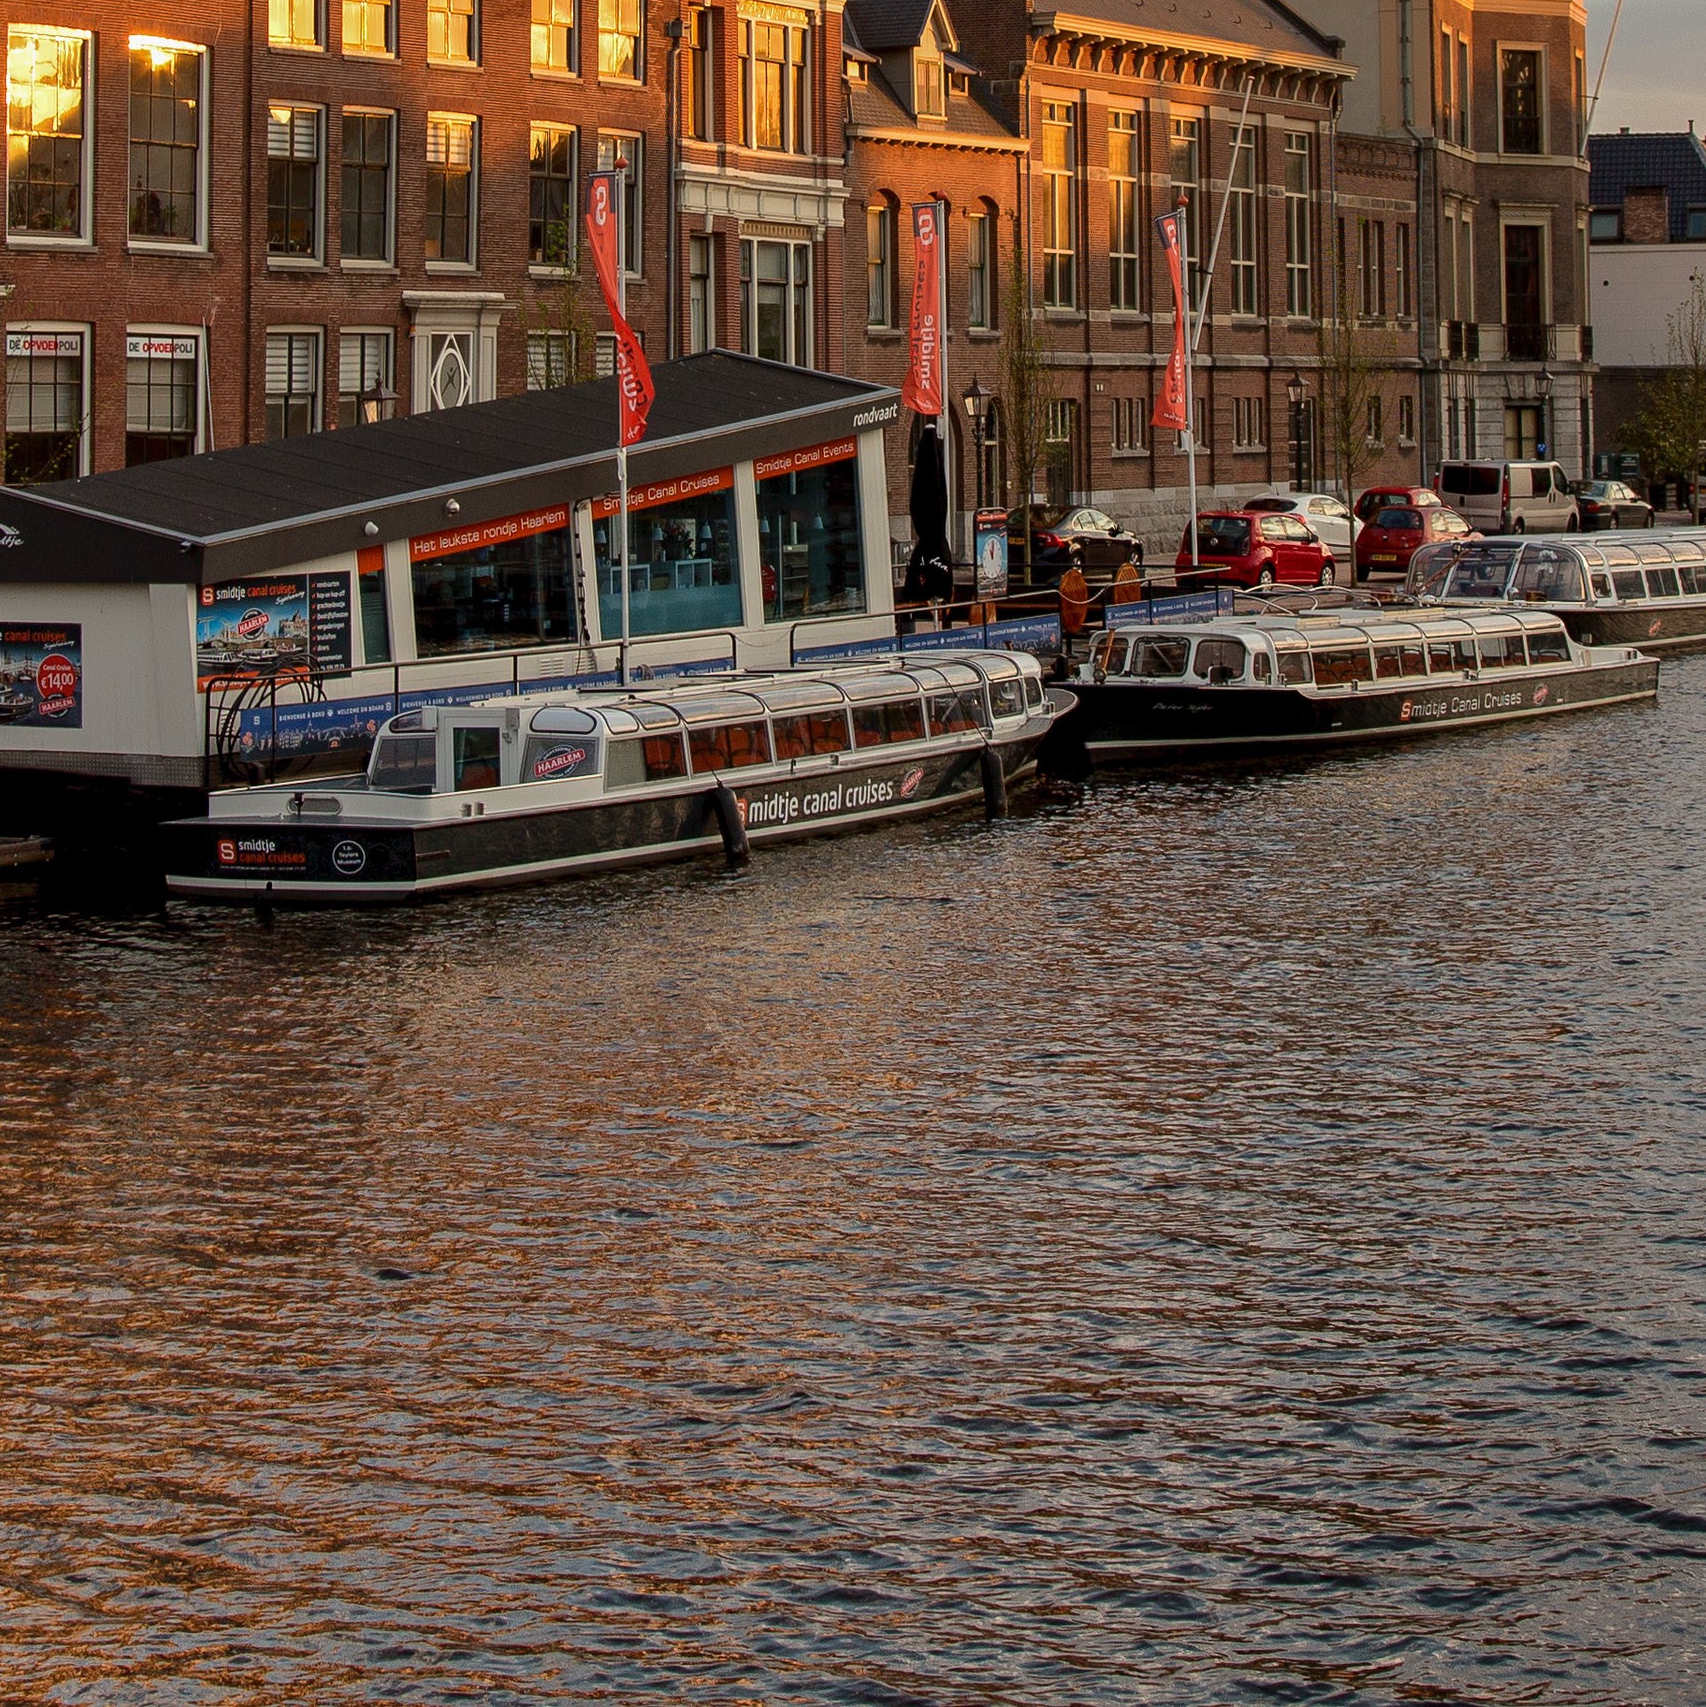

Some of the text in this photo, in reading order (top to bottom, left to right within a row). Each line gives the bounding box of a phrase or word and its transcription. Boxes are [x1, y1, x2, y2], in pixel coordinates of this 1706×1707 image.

[9, 339, 78, 351] DE OPVOEDPOLI
[129, 342, 192, 354] DE OPVOEDPOLI
[853, 403, 898, 427] rondvaart
[756, 443, 854, 474] Smidtje Canal Events
[604, 475, 720, 510] Smdtje Canal Cruises
[414, 511, 565, 554] Het leukste rondje Haarlem
[216, 586, 245, 601] smidtje
[247, 585, 267, 597] canal
[269, 584, 296, 596] cruises
[239, 614, 267, 634] HAARLEM
[4, 630, 30, 641] canal
[32, 631, 66, 642] cruises
[337, 708, 360, 716] WELCOME
[1451, 696, 1481, 713] Canal
[1484, 691, 1522, 708] Cruises
[538, 752, 581, 773] HAARLEM
[803, 784, 841, 815] canal
[846, 779, 893, 808] cruises
[238, 839, 276, 853] smidtje
[240, 852, 306, 863] canal cruises
